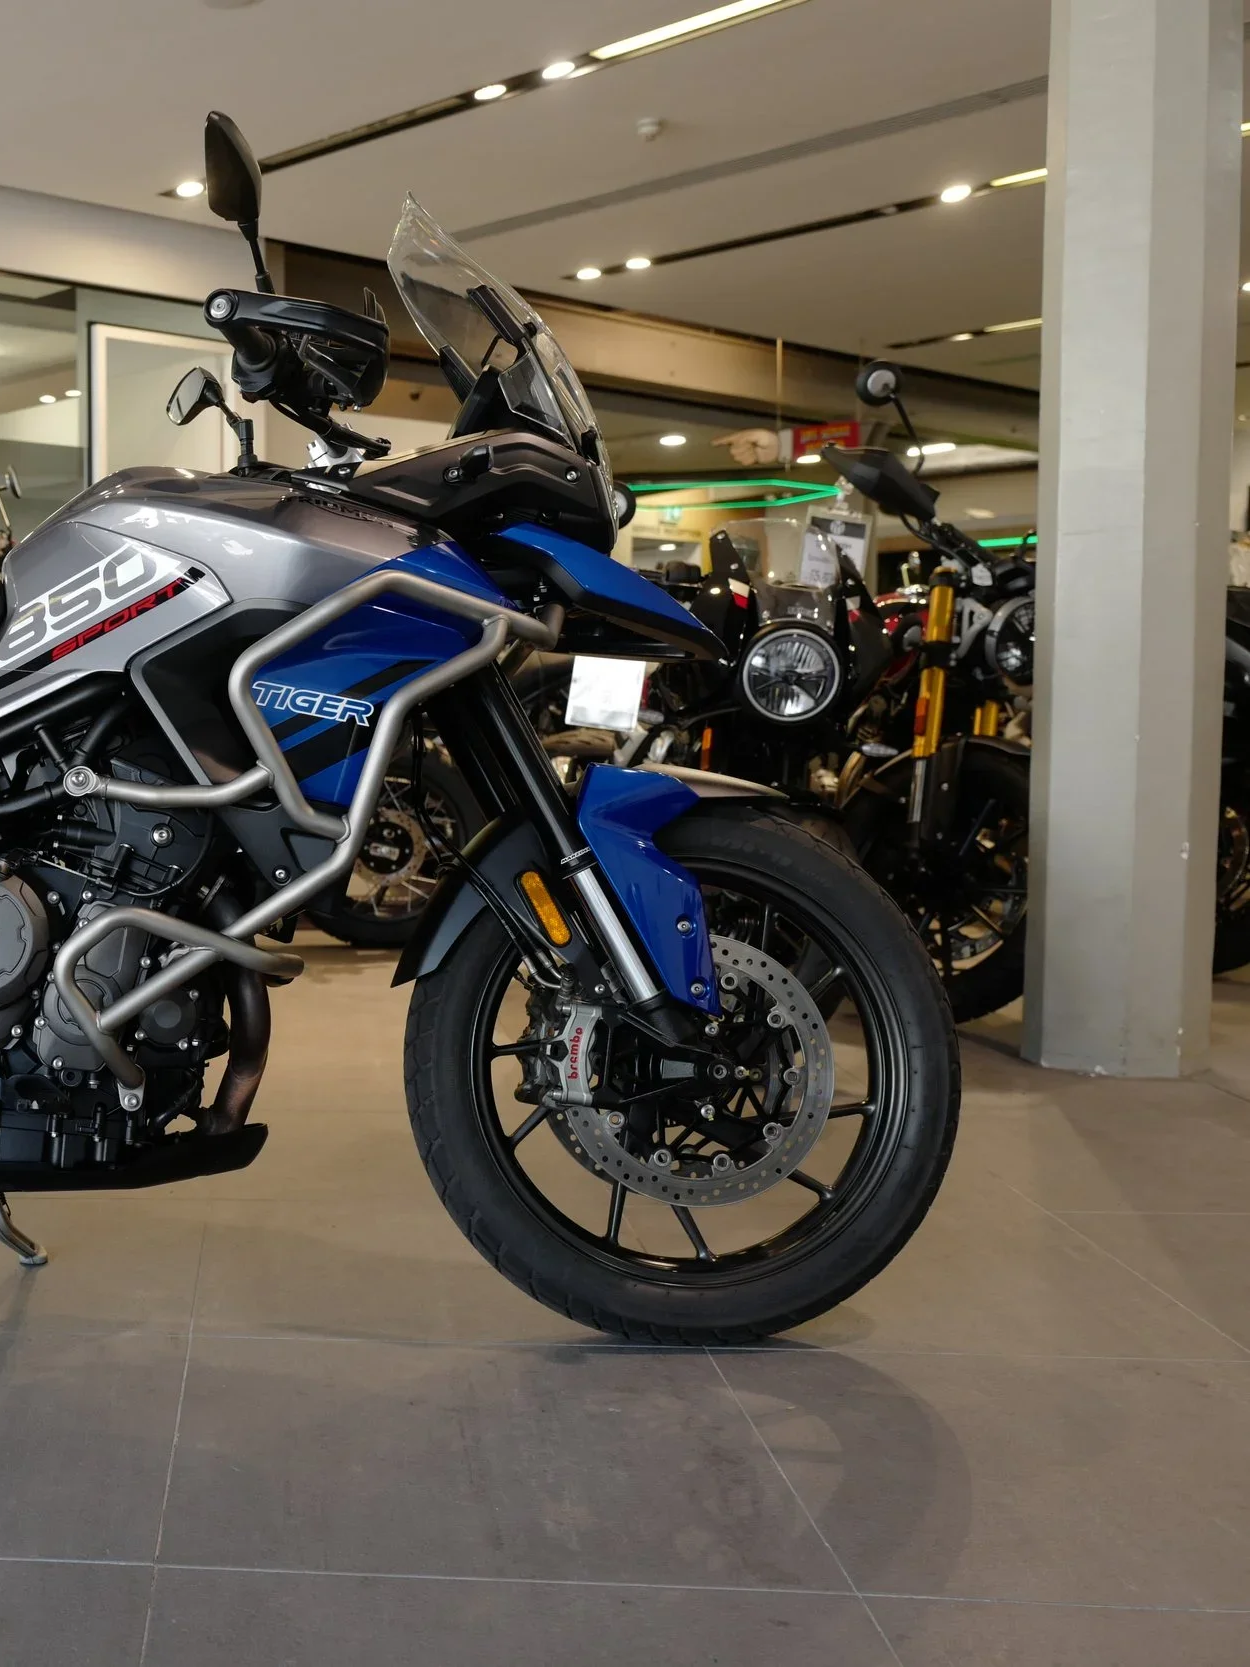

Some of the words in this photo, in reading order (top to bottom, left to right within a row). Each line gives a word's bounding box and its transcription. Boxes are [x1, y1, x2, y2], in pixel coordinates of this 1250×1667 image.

[51, 577, 183, 662] SPORT
[252, 681, 374, 727] TIGER
[567, 1027, 583, 1080] brembo
